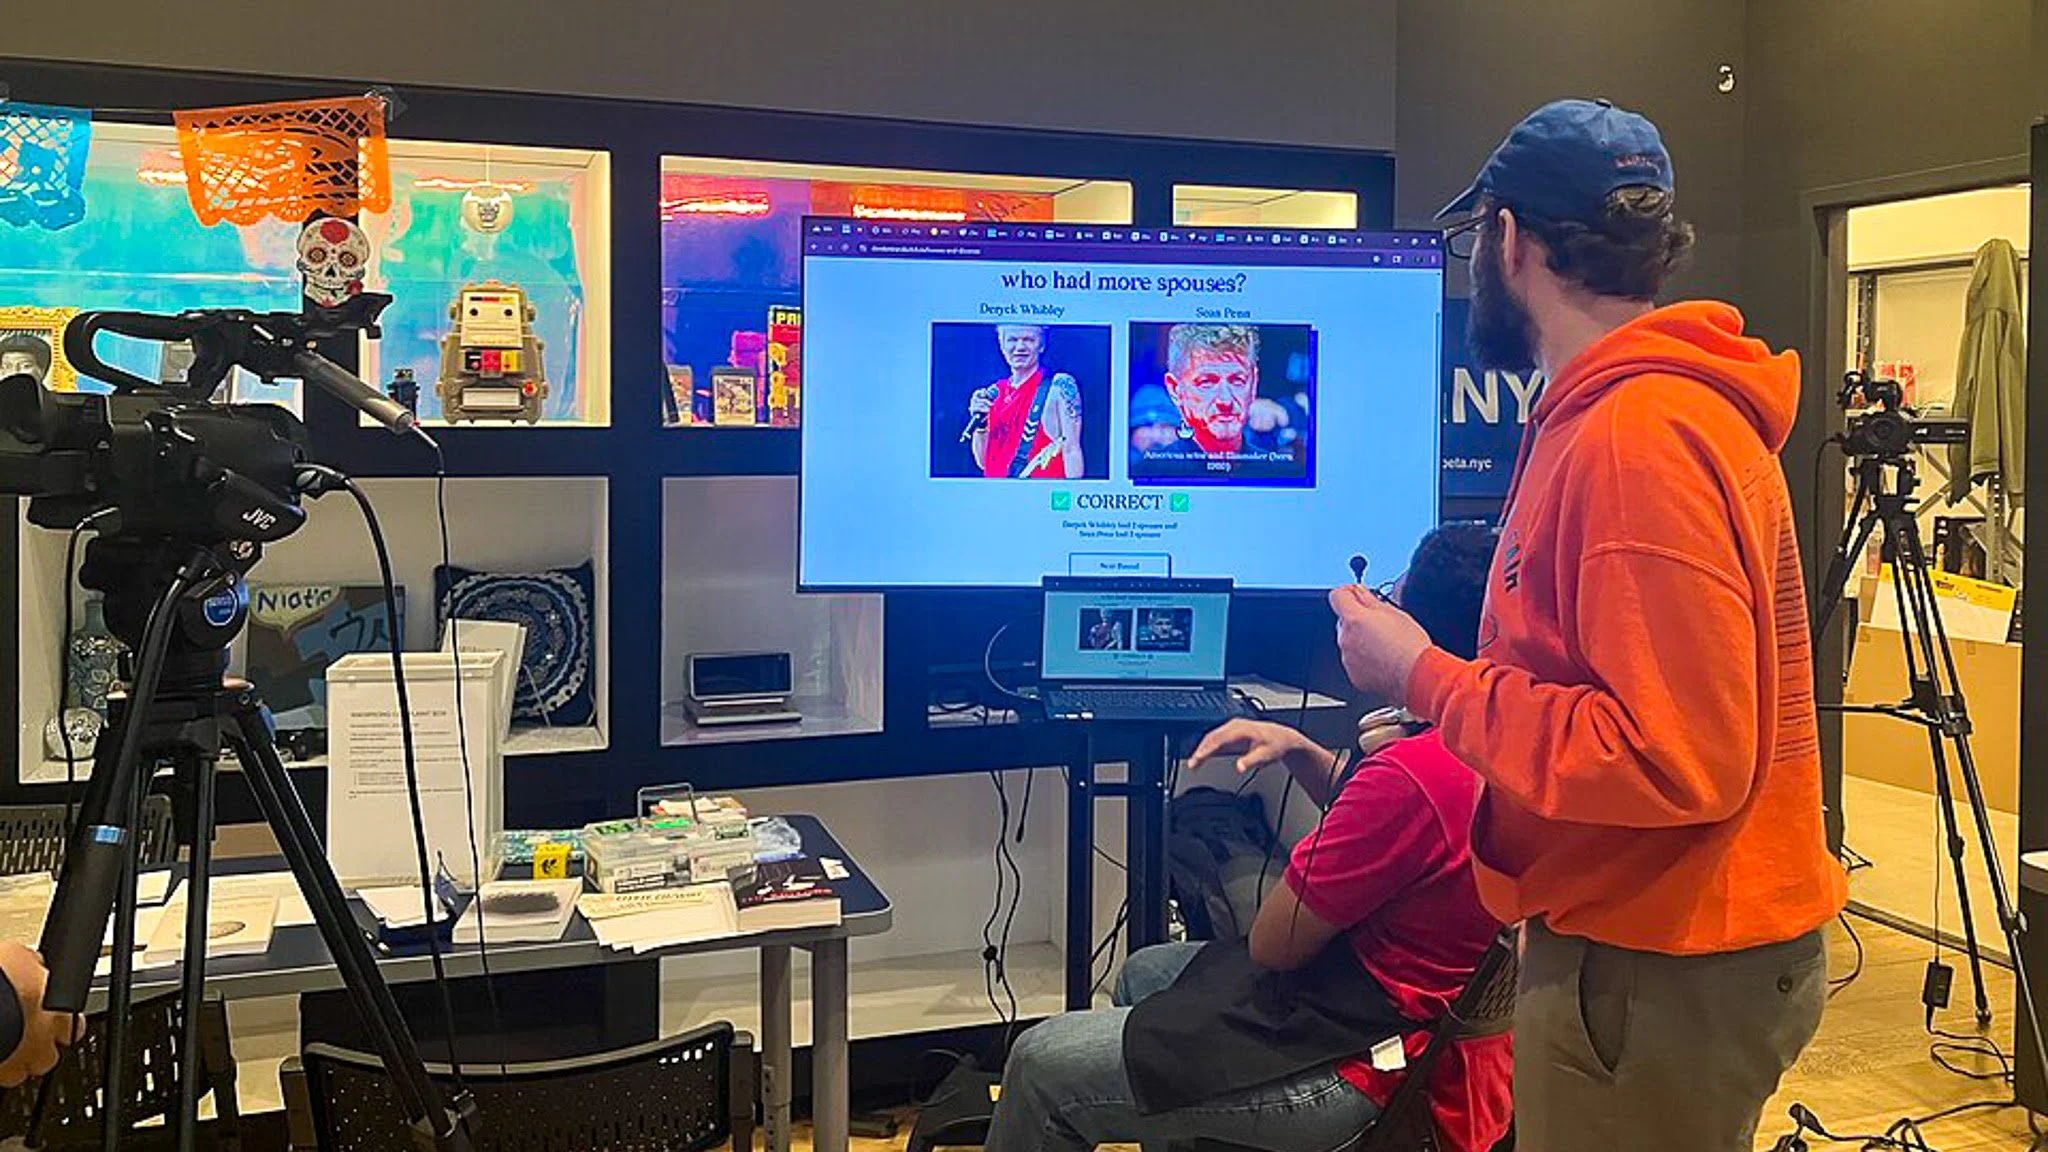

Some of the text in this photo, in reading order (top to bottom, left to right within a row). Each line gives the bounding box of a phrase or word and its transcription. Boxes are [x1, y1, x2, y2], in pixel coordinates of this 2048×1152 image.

[1002, 270, 1247, 297] who had more spouses?
[775, 311, 801, 325] PA
[1443, 367, 1547, 424] NY
[1077, 494, 1164, 511] CORRECT
[242, 507, 276, 530] JVC
